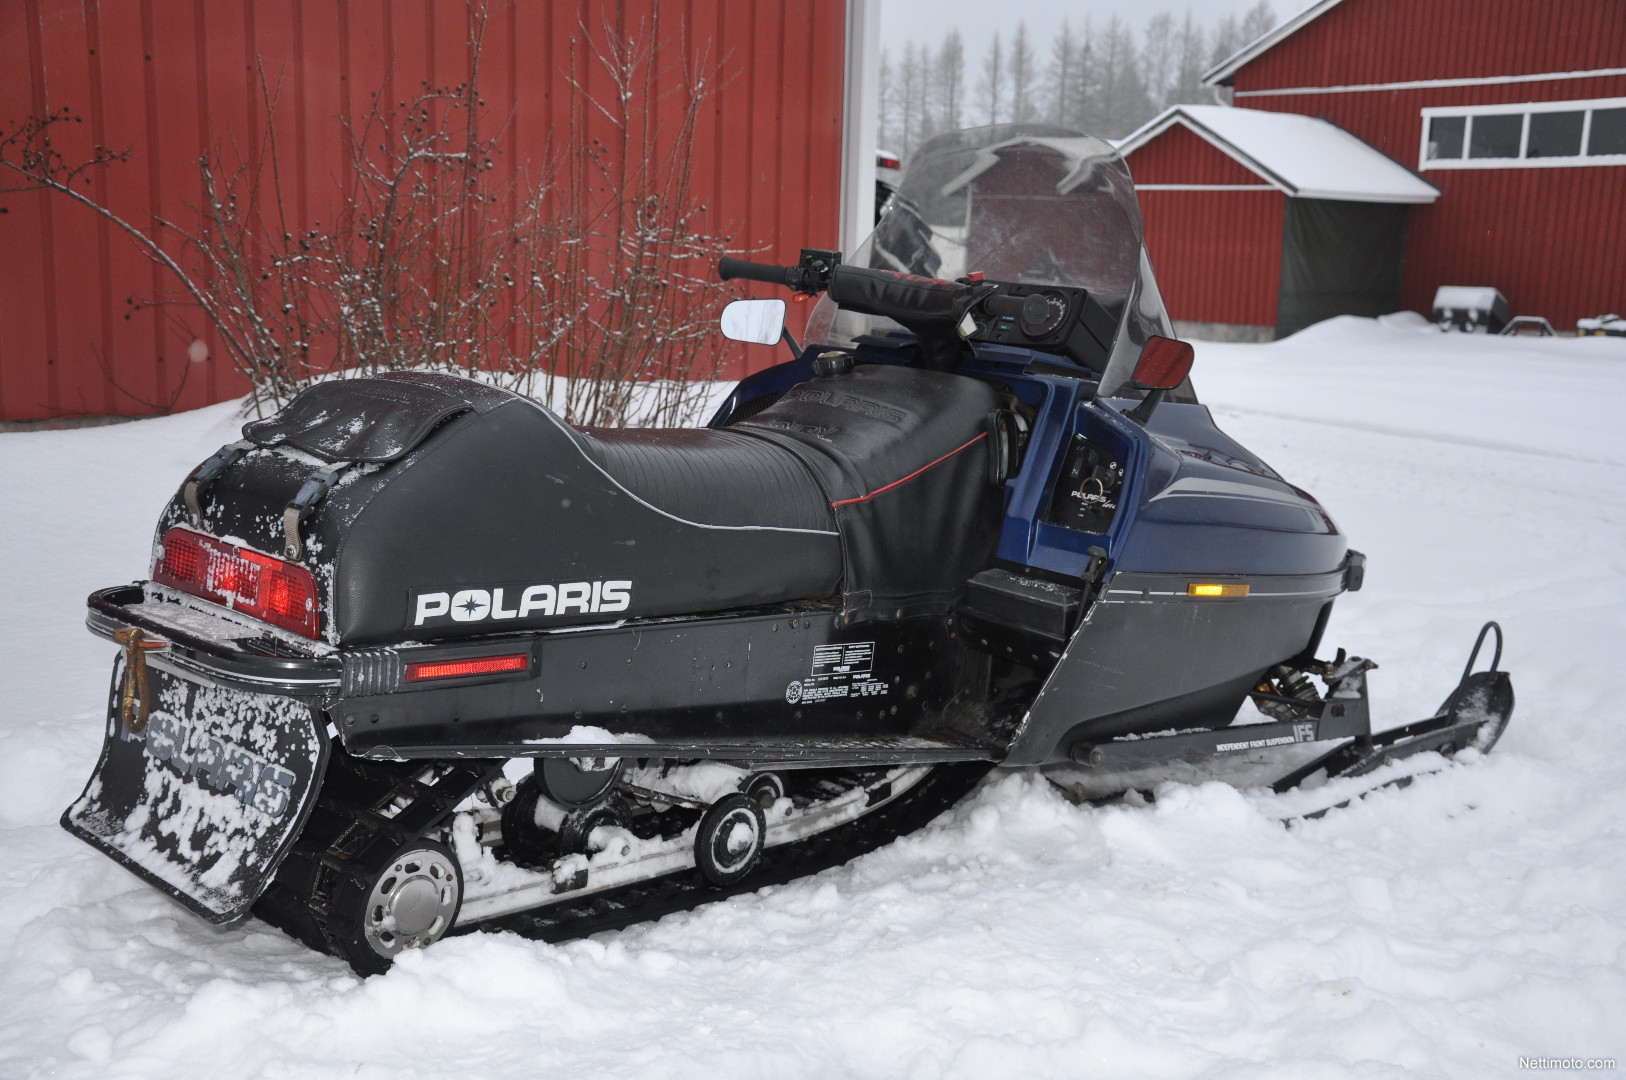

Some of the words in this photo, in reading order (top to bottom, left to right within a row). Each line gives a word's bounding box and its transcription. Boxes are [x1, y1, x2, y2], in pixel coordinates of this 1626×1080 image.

[783, 389, 907, 423] POLARIS
[414, 580, 632, 626] POLARIS
[1216, 742, 1249, 752] INDEPENDENT
[1250, 740, 1265, 748] FRONT
[1266, 736, 1295, 746] SUSPENSION
[1293, 724, 1315, 743] IFS
[120, 704, 295, 818] OLARIS
